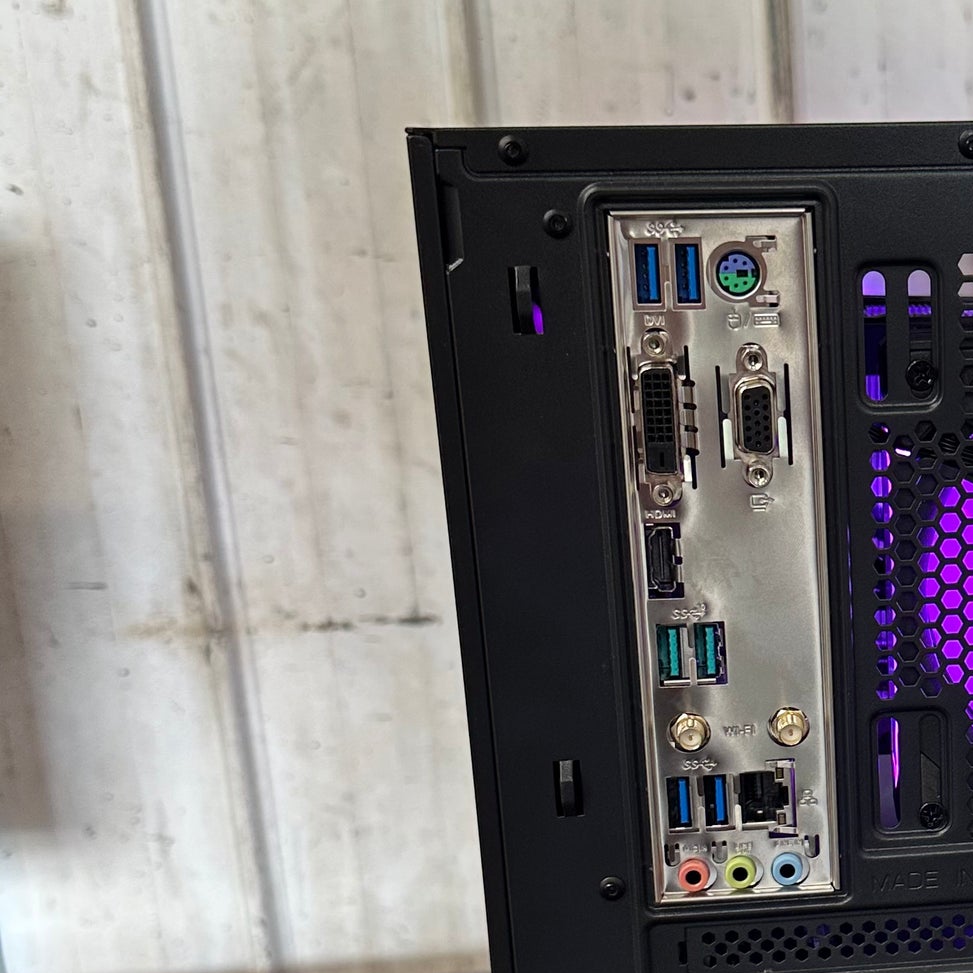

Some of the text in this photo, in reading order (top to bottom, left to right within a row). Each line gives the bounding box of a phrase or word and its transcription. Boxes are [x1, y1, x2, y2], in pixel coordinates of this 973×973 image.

[643, 314, 666, 327] DVI
[644, 509, 677, 520] HDMI
[873, 870, 939, 893] MADE
